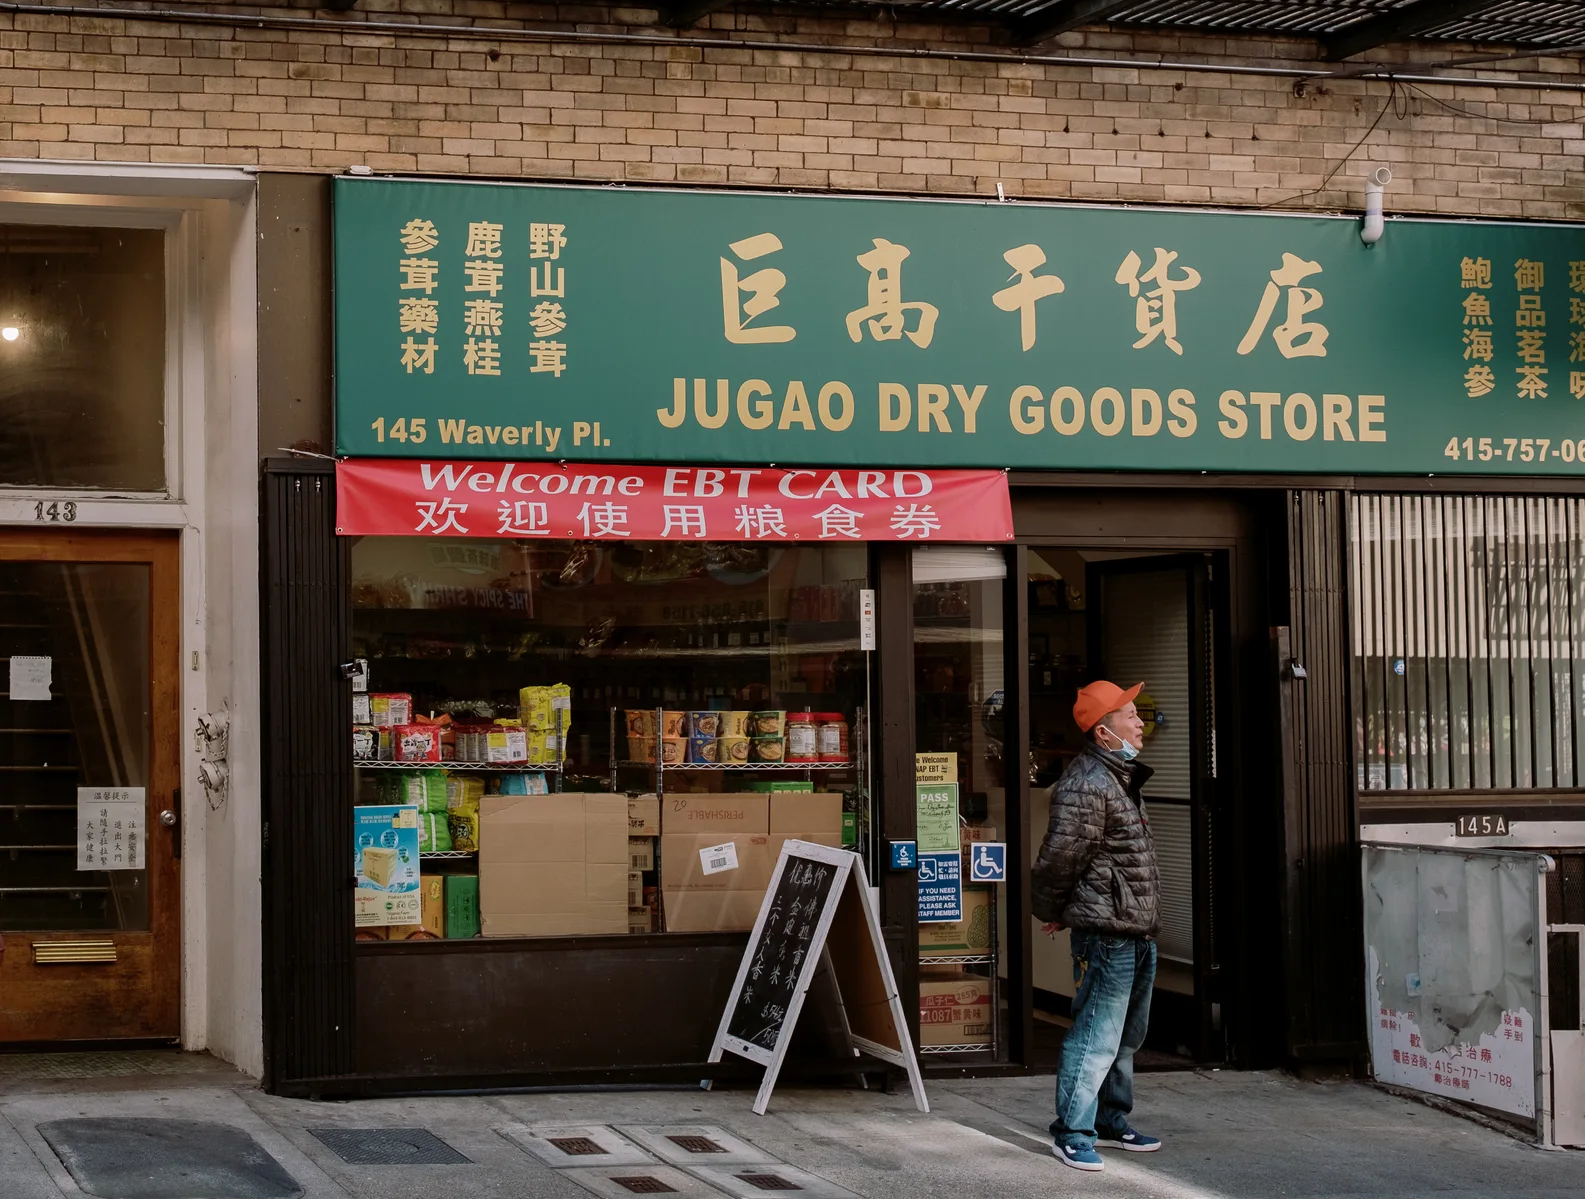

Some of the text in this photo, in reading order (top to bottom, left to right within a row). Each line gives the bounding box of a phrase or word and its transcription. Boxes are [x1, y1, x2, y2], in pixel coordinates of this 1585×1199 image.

[399, 218, 439, 374] 參茸藥材
[463, 221, 504, 376] 鹿茸燕桂
[529, 222, 568, 378] 野山參茸
[1460, 256, 1496, 399] 鮑魚海參
[1514, 258, 1549, 400] 御品茗茶
[656, 377, 1387, 443] JUGAO DRY GOODS STORE
[371, 417, 611, 453] 145 Waverly Pl.
[419, 463, 934, 500] Welcome EBT CARD
[34, 501, 77, 521] 143
[415, 498, 942, 539] 欢迎使用粮食券
[687, 810, 744, 820] PERISHABLE
[920, 793, 949, 803] PASS
[1435, 1060, 1512, 1088] 415-777-1788
